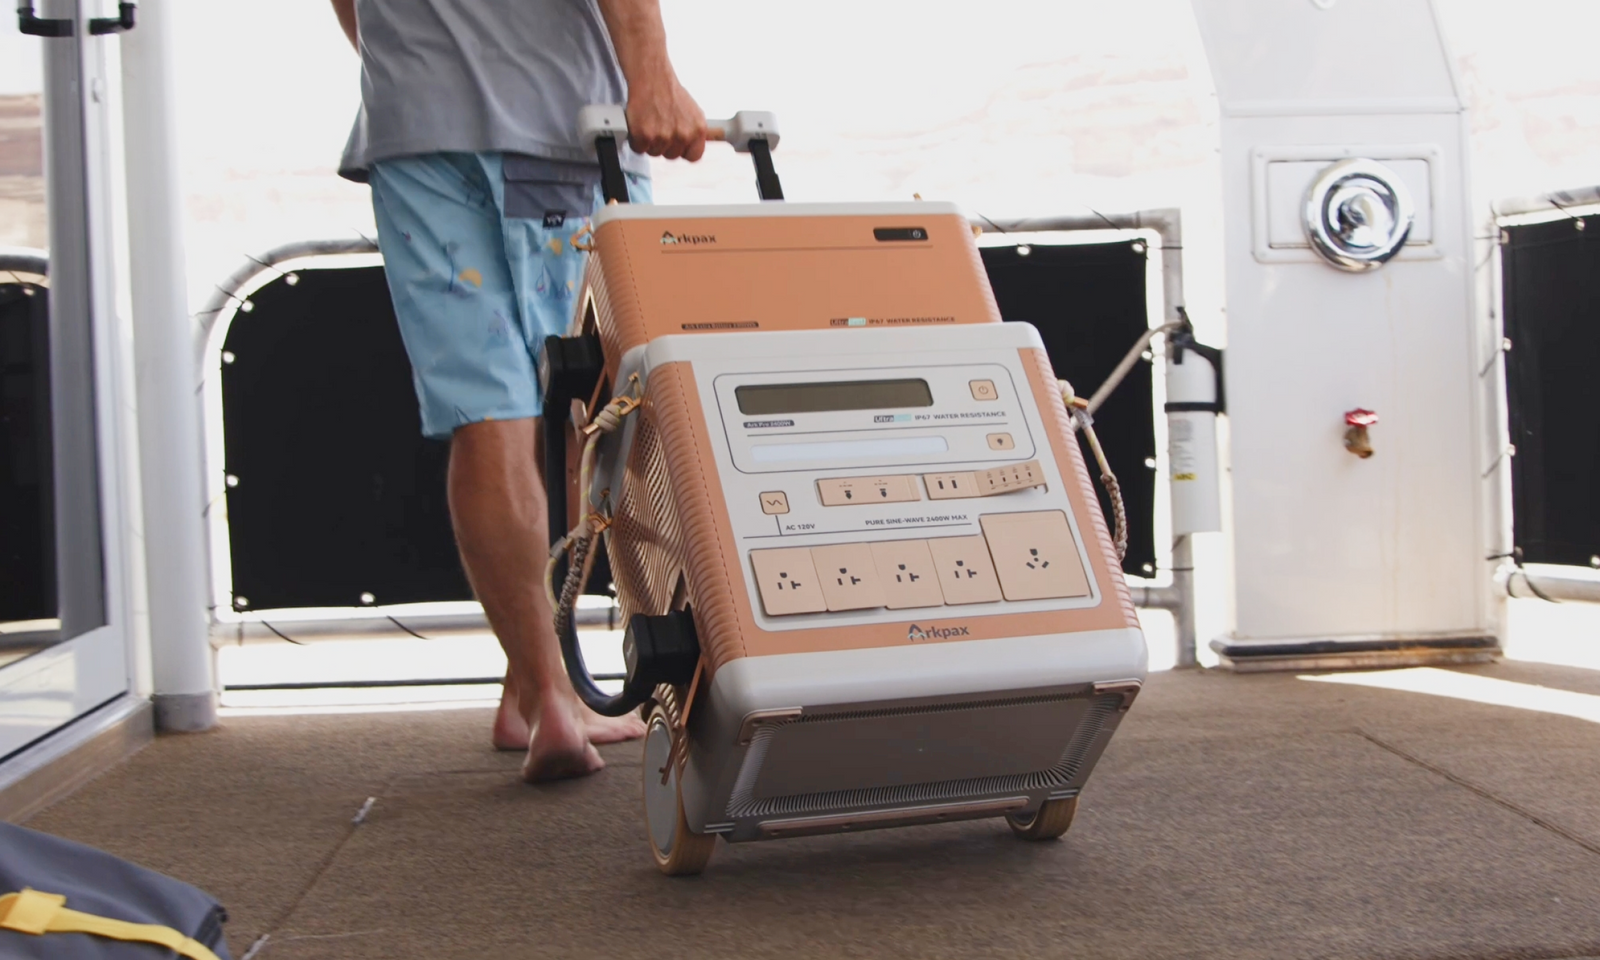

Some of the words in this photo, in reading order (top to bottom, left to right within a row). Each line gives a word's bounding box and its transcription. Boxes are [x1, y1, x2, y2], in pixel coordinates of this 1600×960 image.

[660, 230, 717, 245] Arkpax
[960, 411, 1007, 419] RESISTANCE
[907, 623, 970, 642] Arkpax
